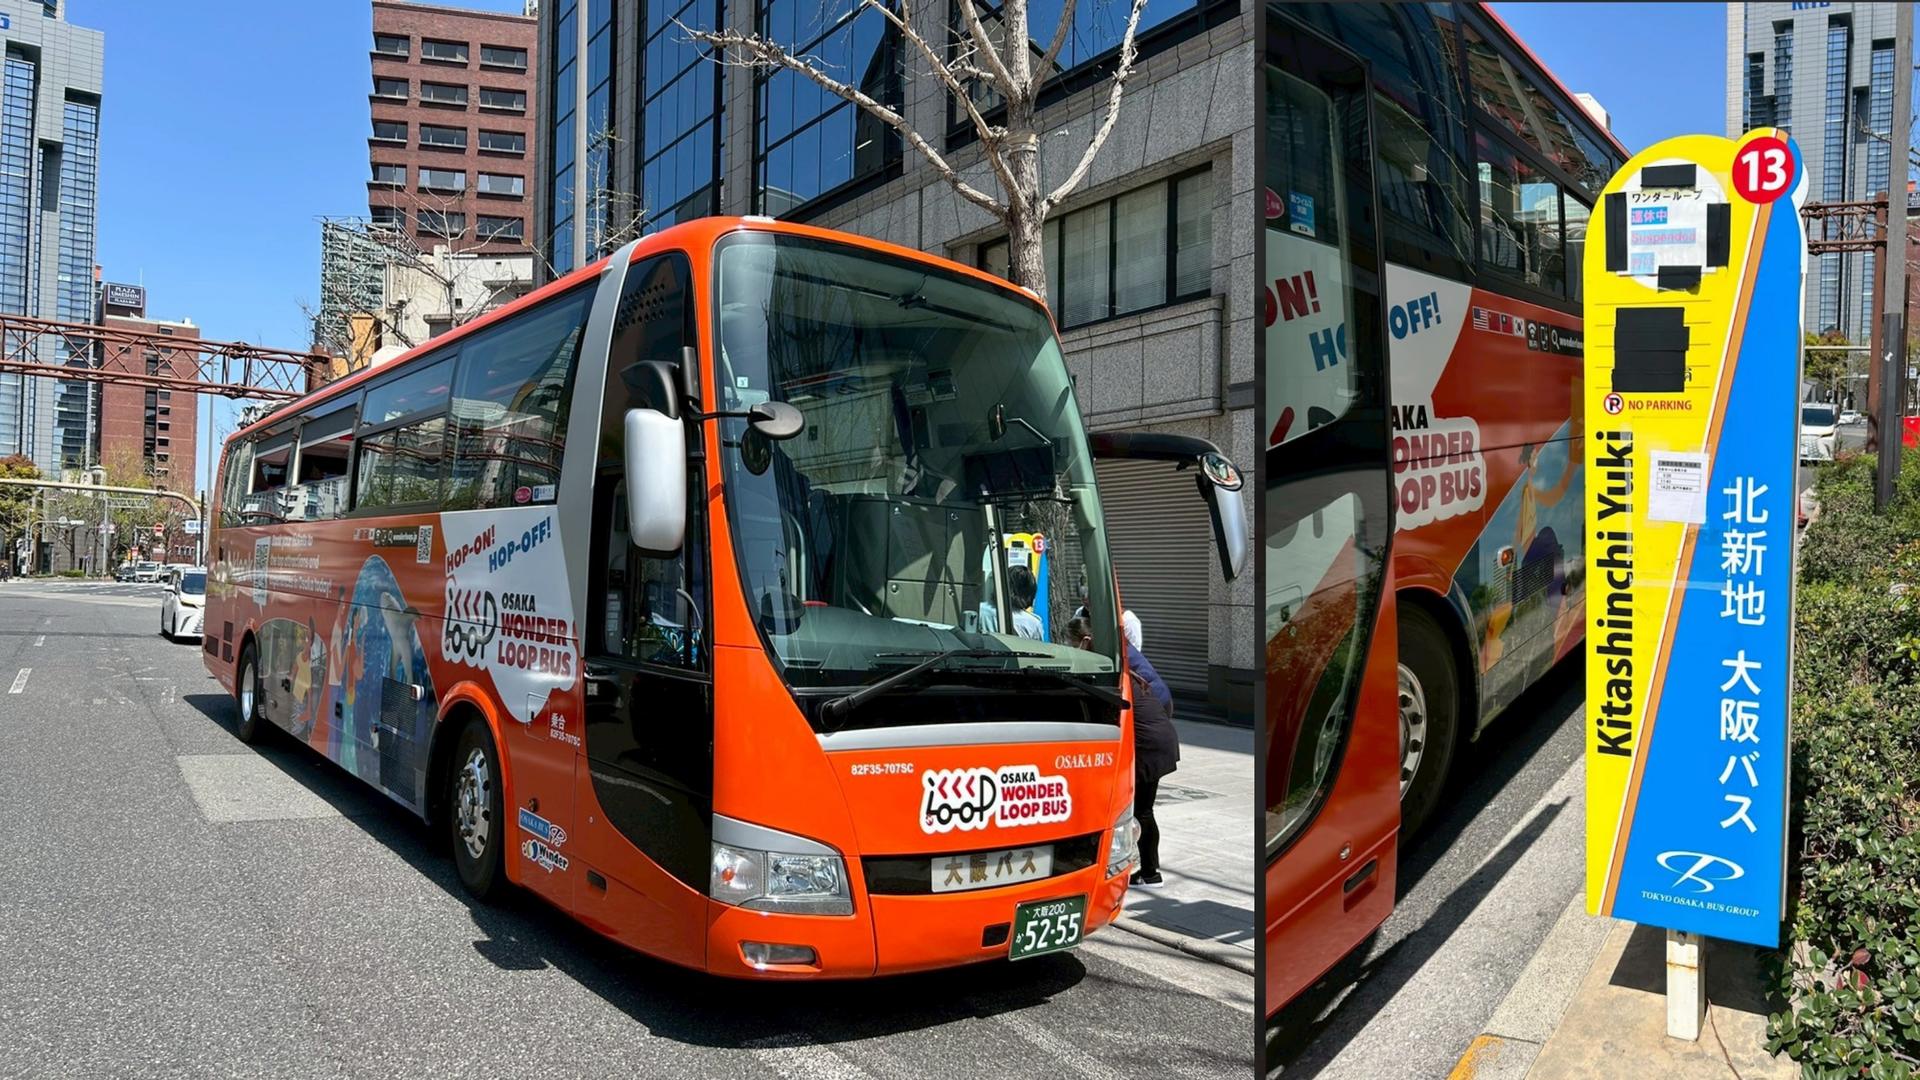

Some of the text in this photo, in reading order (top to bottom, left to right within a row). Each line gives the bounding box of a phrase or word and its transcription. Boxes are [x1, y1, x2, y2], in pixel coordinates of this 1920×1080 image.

[1741, 148, 1787, 192] 13
[1628, 400, 1692, 411] NO PARKING
[1440, 466, 1481, 506] BUS
[447, 524, 495, 573] HOP-ON!
[489, 516, 551, 573] HOP-OFF!
[1033, 539, 1044, 550] 13
[1720, 476, 1769, 626] 北新地
[501, 592, 536, 612] OSAKA
[1596, 431, 1633, 757] Kitashinchi Yuki
[500, 613, 568, 646] WONDER
[497, 640, 571, 677] LOOP BUS
[1719, 650, 1762, 833] 大阪バス
[851, 763, 914, 775] 82F35-707SC
[1054, 752, 1114, 770] OSAKA BUS
[1000, 772, 1036, 784] OSAKA
[1001, 783, 1064, 801] WONDER
[1000, 799, 1068, 820] LOOP BUS
[943, 850, 1037, 886] 大阪バス
[1641, 890, 1760, 918] TOKYO OSAKA BUS GROUP
